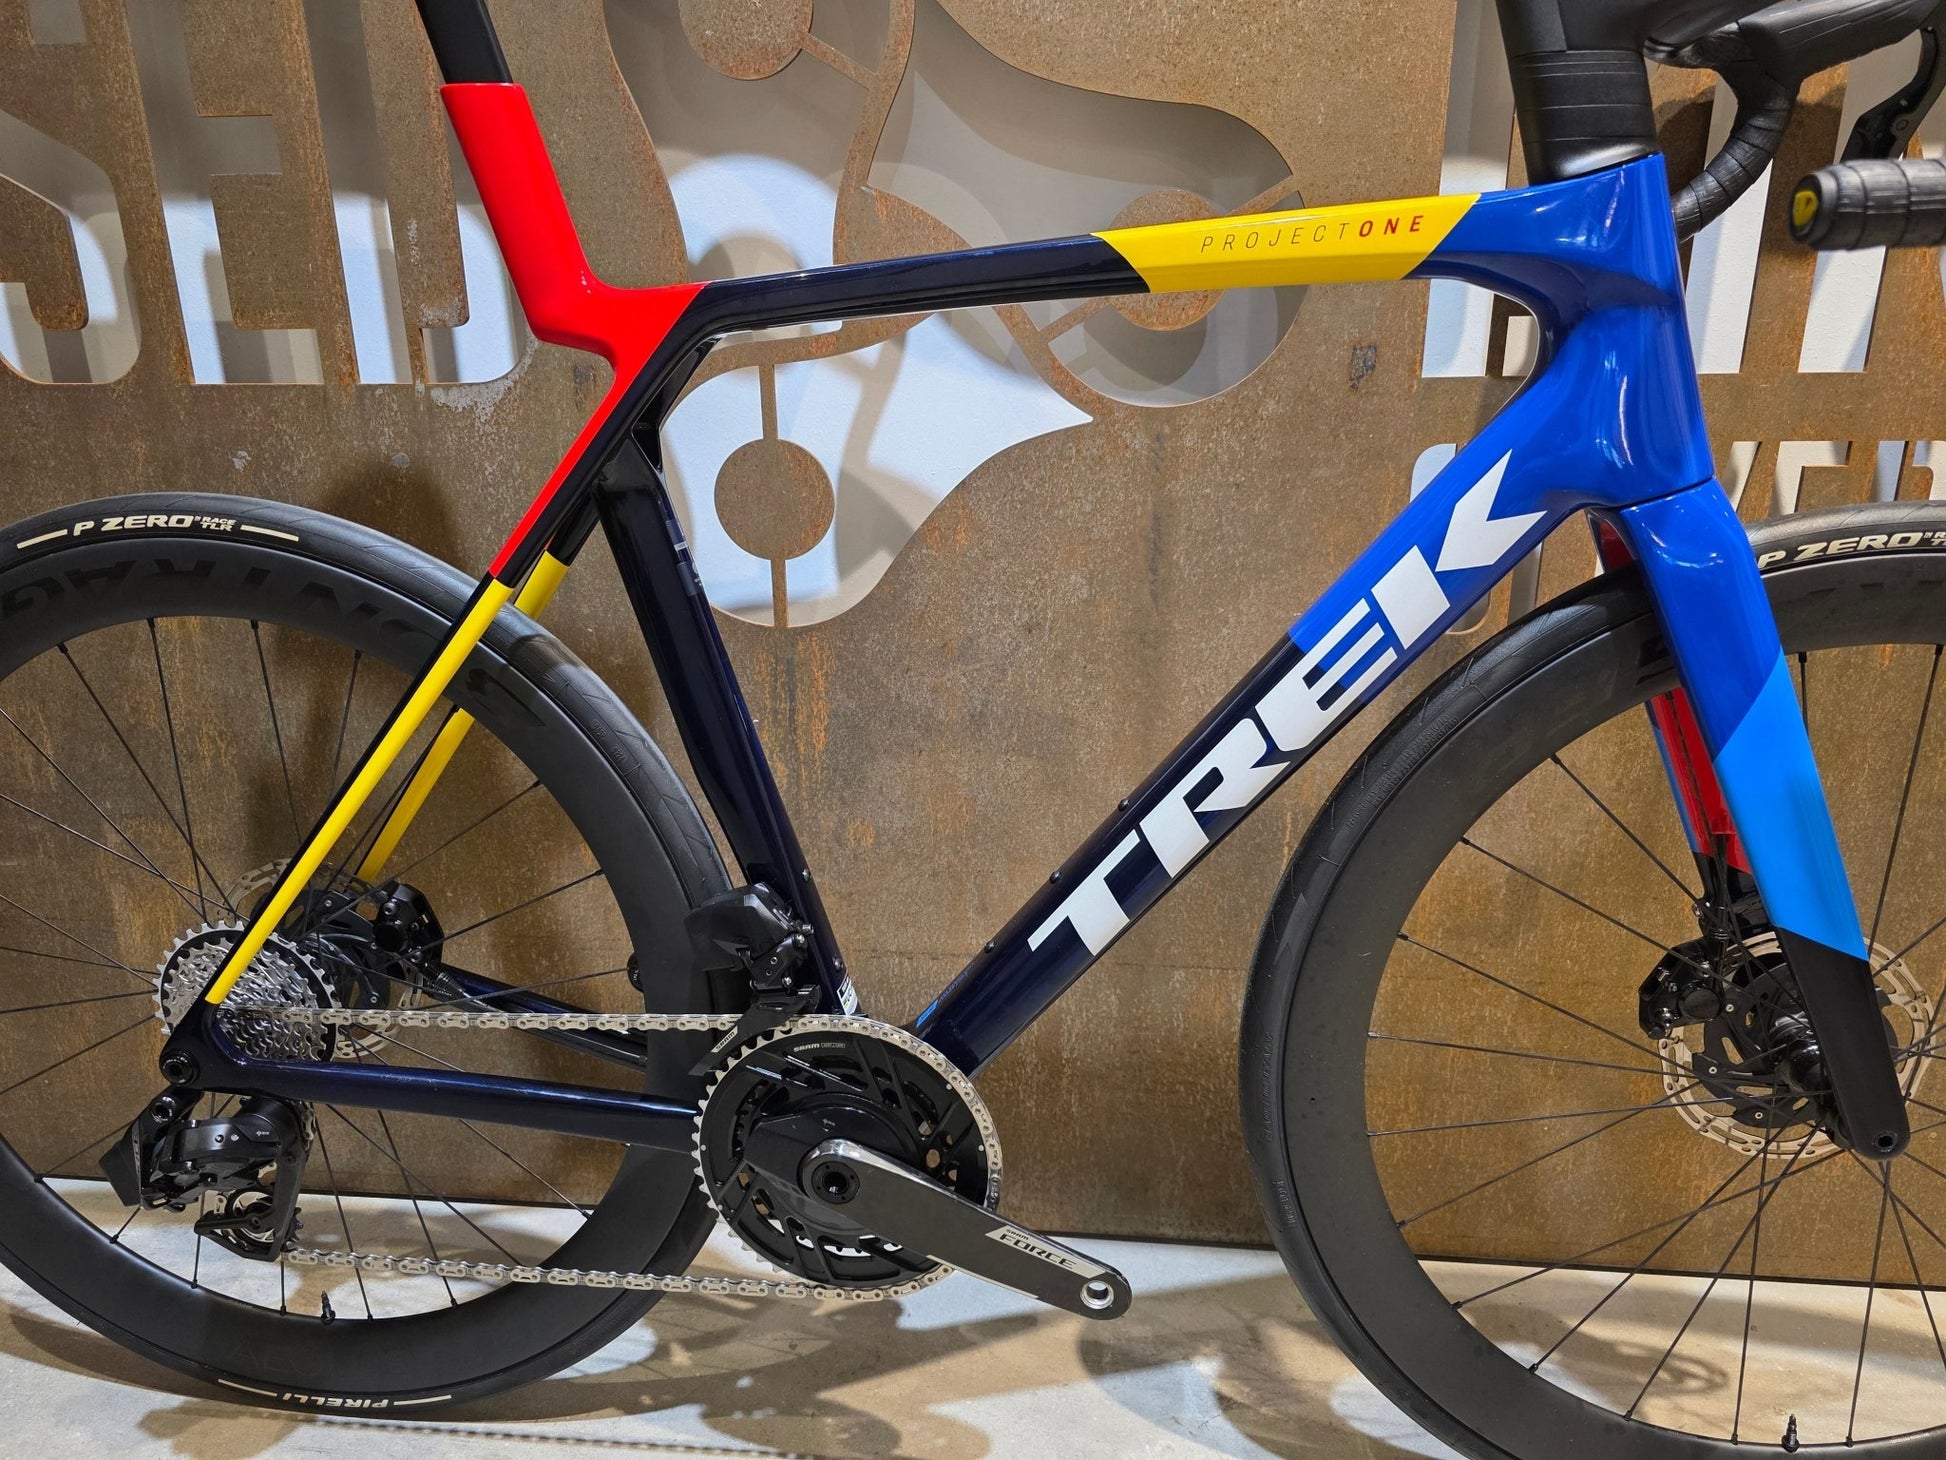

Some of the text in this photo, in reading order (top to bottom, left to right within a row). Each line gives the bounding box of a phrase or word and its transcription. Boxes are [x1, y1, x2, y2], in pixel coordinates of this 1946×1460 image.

[73, 520, 95, 537] P
[200, 522, 234, 532] TLR
[201, 516, 237, 526] RACE
[1757, 550, 1787, 569] P
[1027, 449, 1548, 955] TREK
[999, 1233, 1078, 1270] FORCE
[282, 1392, 389, 1408] PIRELLI
